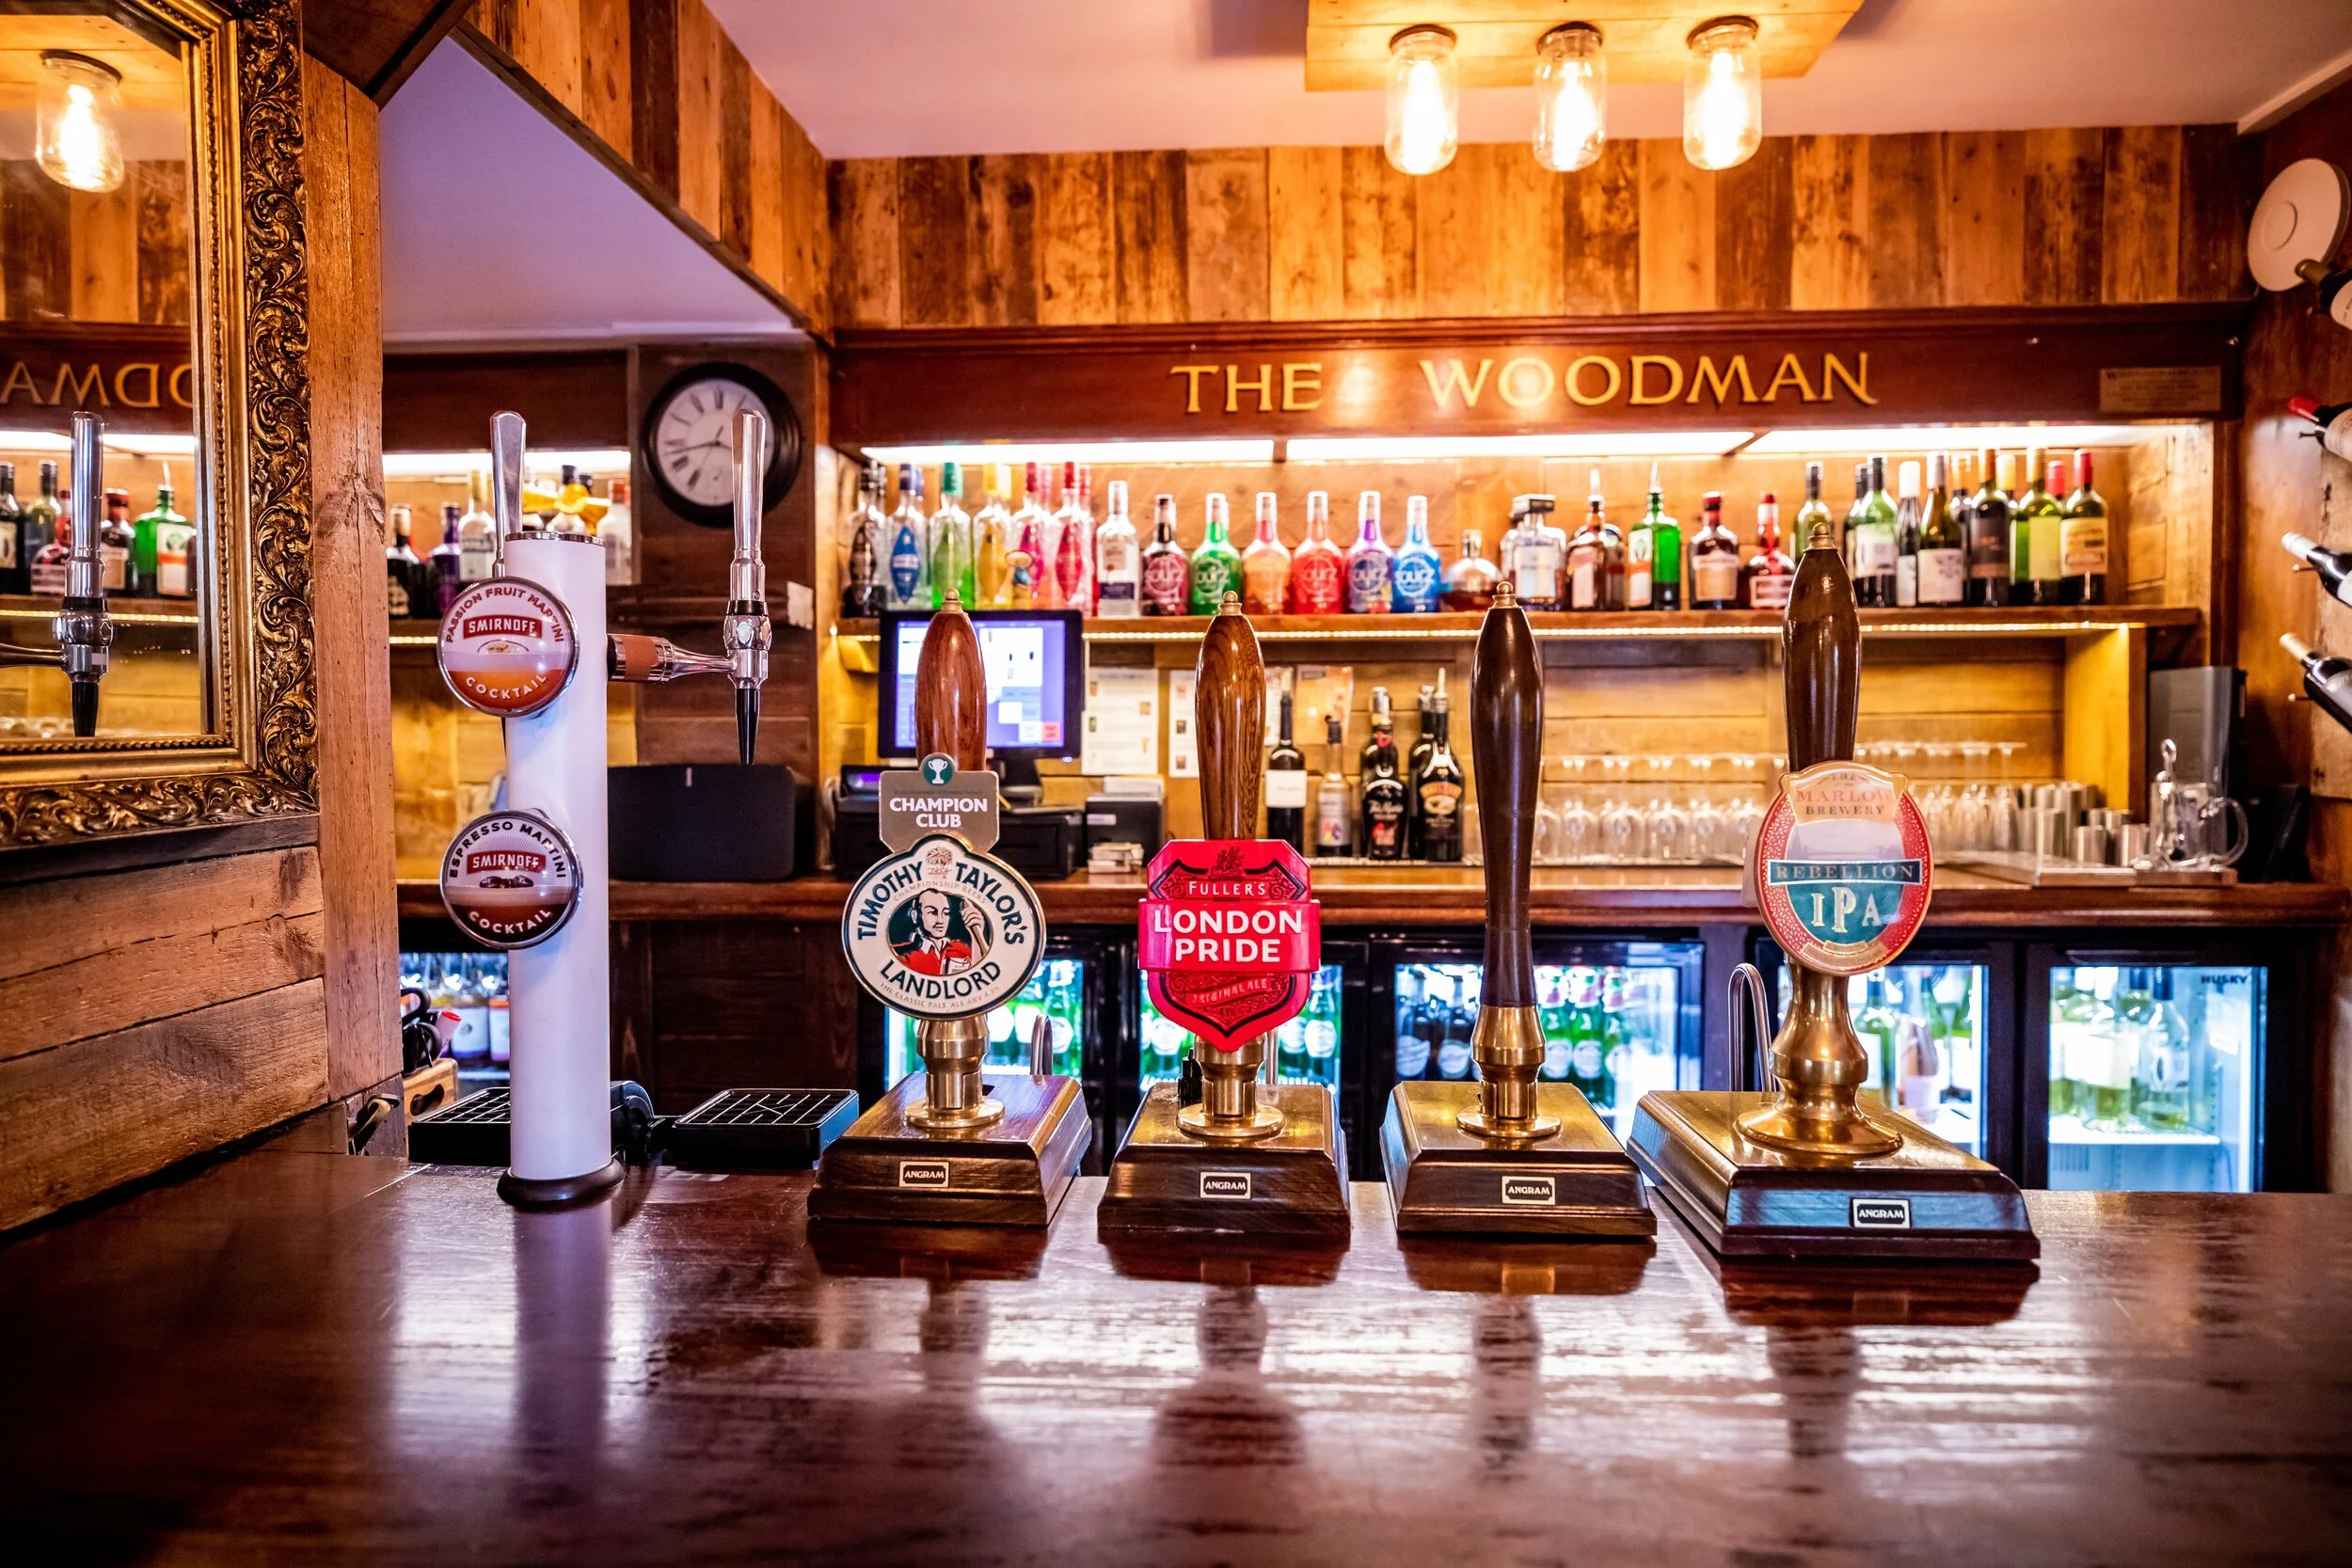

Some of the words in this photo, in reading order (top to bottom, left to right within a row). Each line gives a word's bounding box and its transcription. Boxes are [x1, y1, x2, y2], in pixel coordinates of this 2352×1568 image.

[1170, 362, 1323, 414] THE
[1420, 352, 1879, 409] WOODMAN
[445, 593, 483, 643] PASSION
[485, 587, 527, 599] FRUIT
[527, 594, 564, 642] MARTINI
[469, 618, 536, 634] SMIRNOFF
[466, 673, 548, 700] COCKTAIL
[1797, 789, 1894, 802] MARLOW
[889, 798, 988, 813] CHAMPION
[1805, 805, 1885, 816] BREWERY
[915, 814, 961, 828] CLUB
[449, 821, 513, 879] ESPRESSO
[519, 823, 566, 878] MARTINI
[472, 853, 540, 869] SMIRNOFF
[1775, 864, 1915, 879] REBELLION
[893, 880, 960, 901] CHAMPIONSHIP
[961, 886, 986, 904] BEERS
[857, 861, 923, 940] TIMOTHY
[955, 862, 1025, 945] TAYLOR'S
[1811, 887, 1882, 933] IPA
[469, 909, 551, 935] COCKTAIL
[1154, 910, 1303, 934] LONDON
[1175, 939, 1280, 963] PRIDE
[880, 959, 1002, 1000] LANDLORD
[895, 992, 926, 1006] CLASSIC
[928, 1001, 946, 1009] PALE
[904, 1170, 945, 1179] ANGRAM
[1205, 1180, 1247, 1190] ANGRAM
[1508, 1186, 1550, 1195] ANGRAM
[1859, 1209, 1904, 1219] ANGRAM
